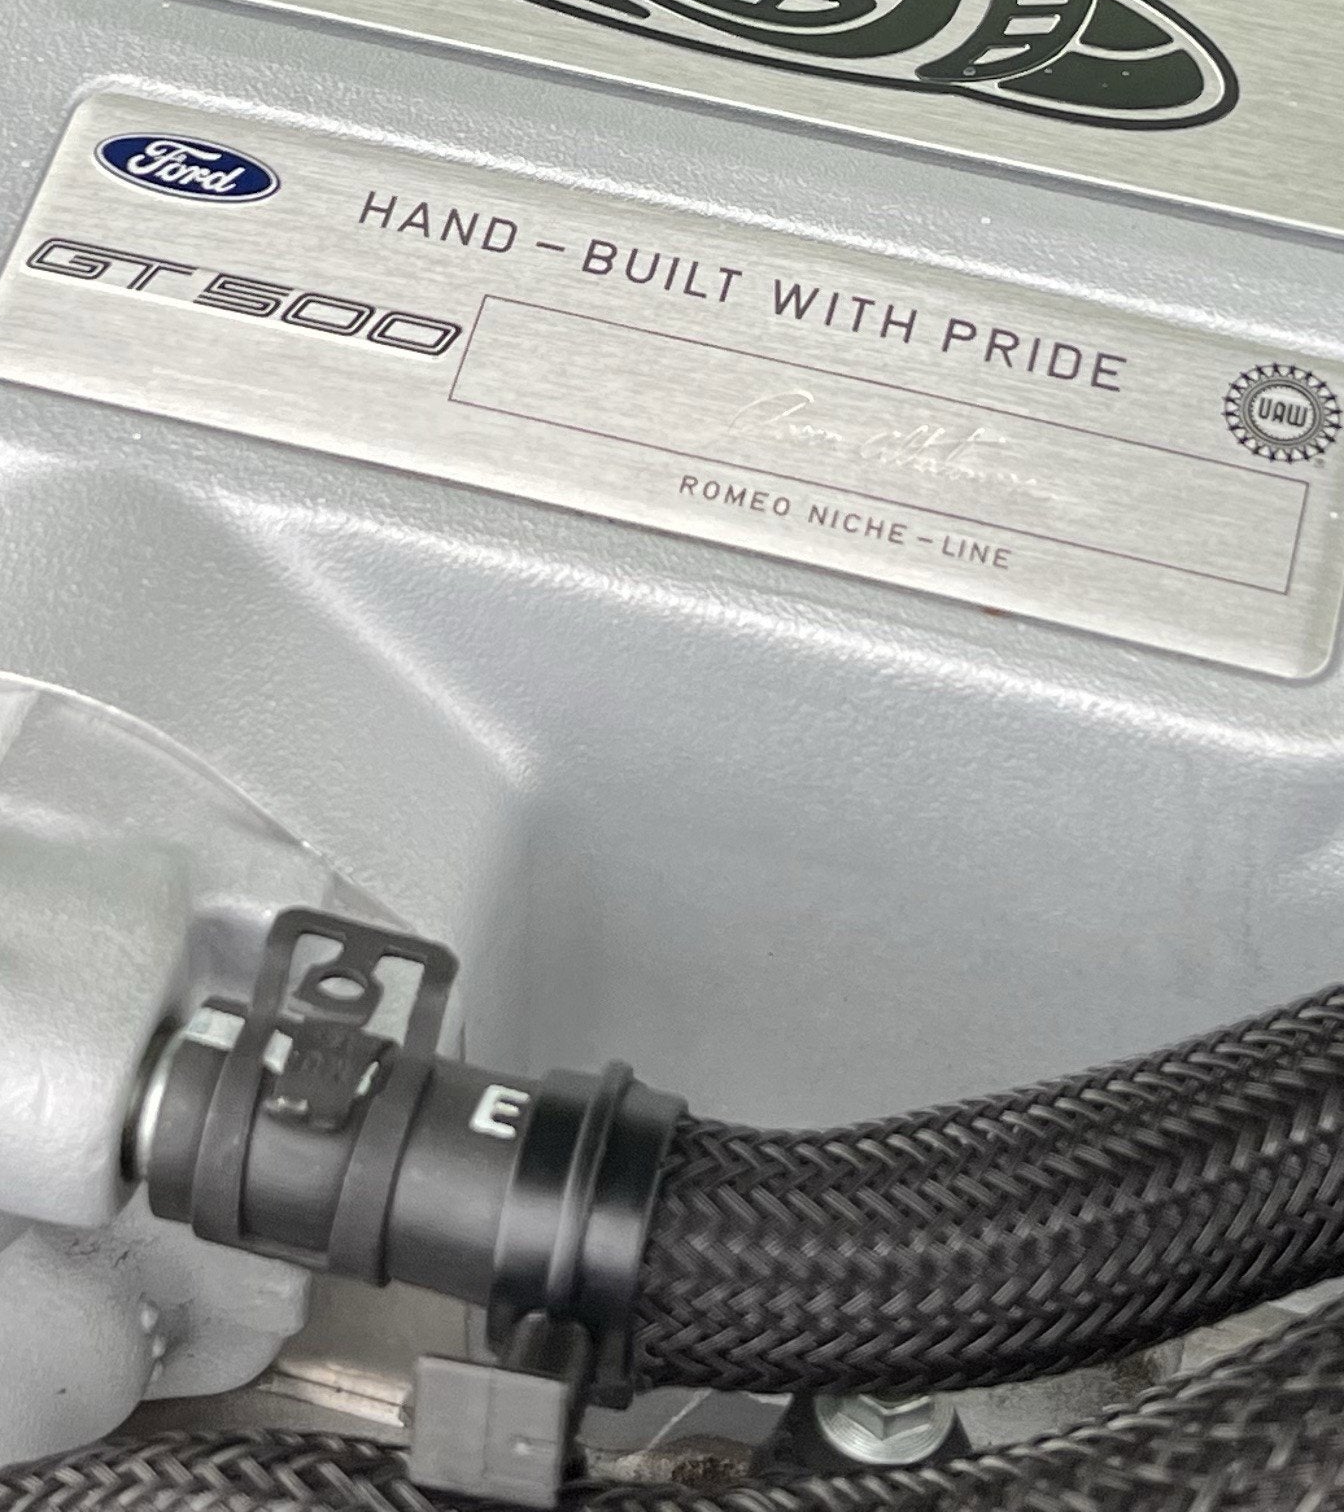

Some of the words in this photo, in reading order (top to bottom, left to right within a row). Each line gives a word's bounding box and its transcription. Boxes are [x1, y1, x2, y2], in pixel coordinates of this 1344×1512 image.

[126, 139, 246, 193] Ford
[773, 278, 918, 344] WITH
[941, 317, 1128, 393] PRIDE
[1258, 396, 1308, 428] UAW
[678, 474, 791, 517] ROMEO
[469, 1084, 531, 1140] E
